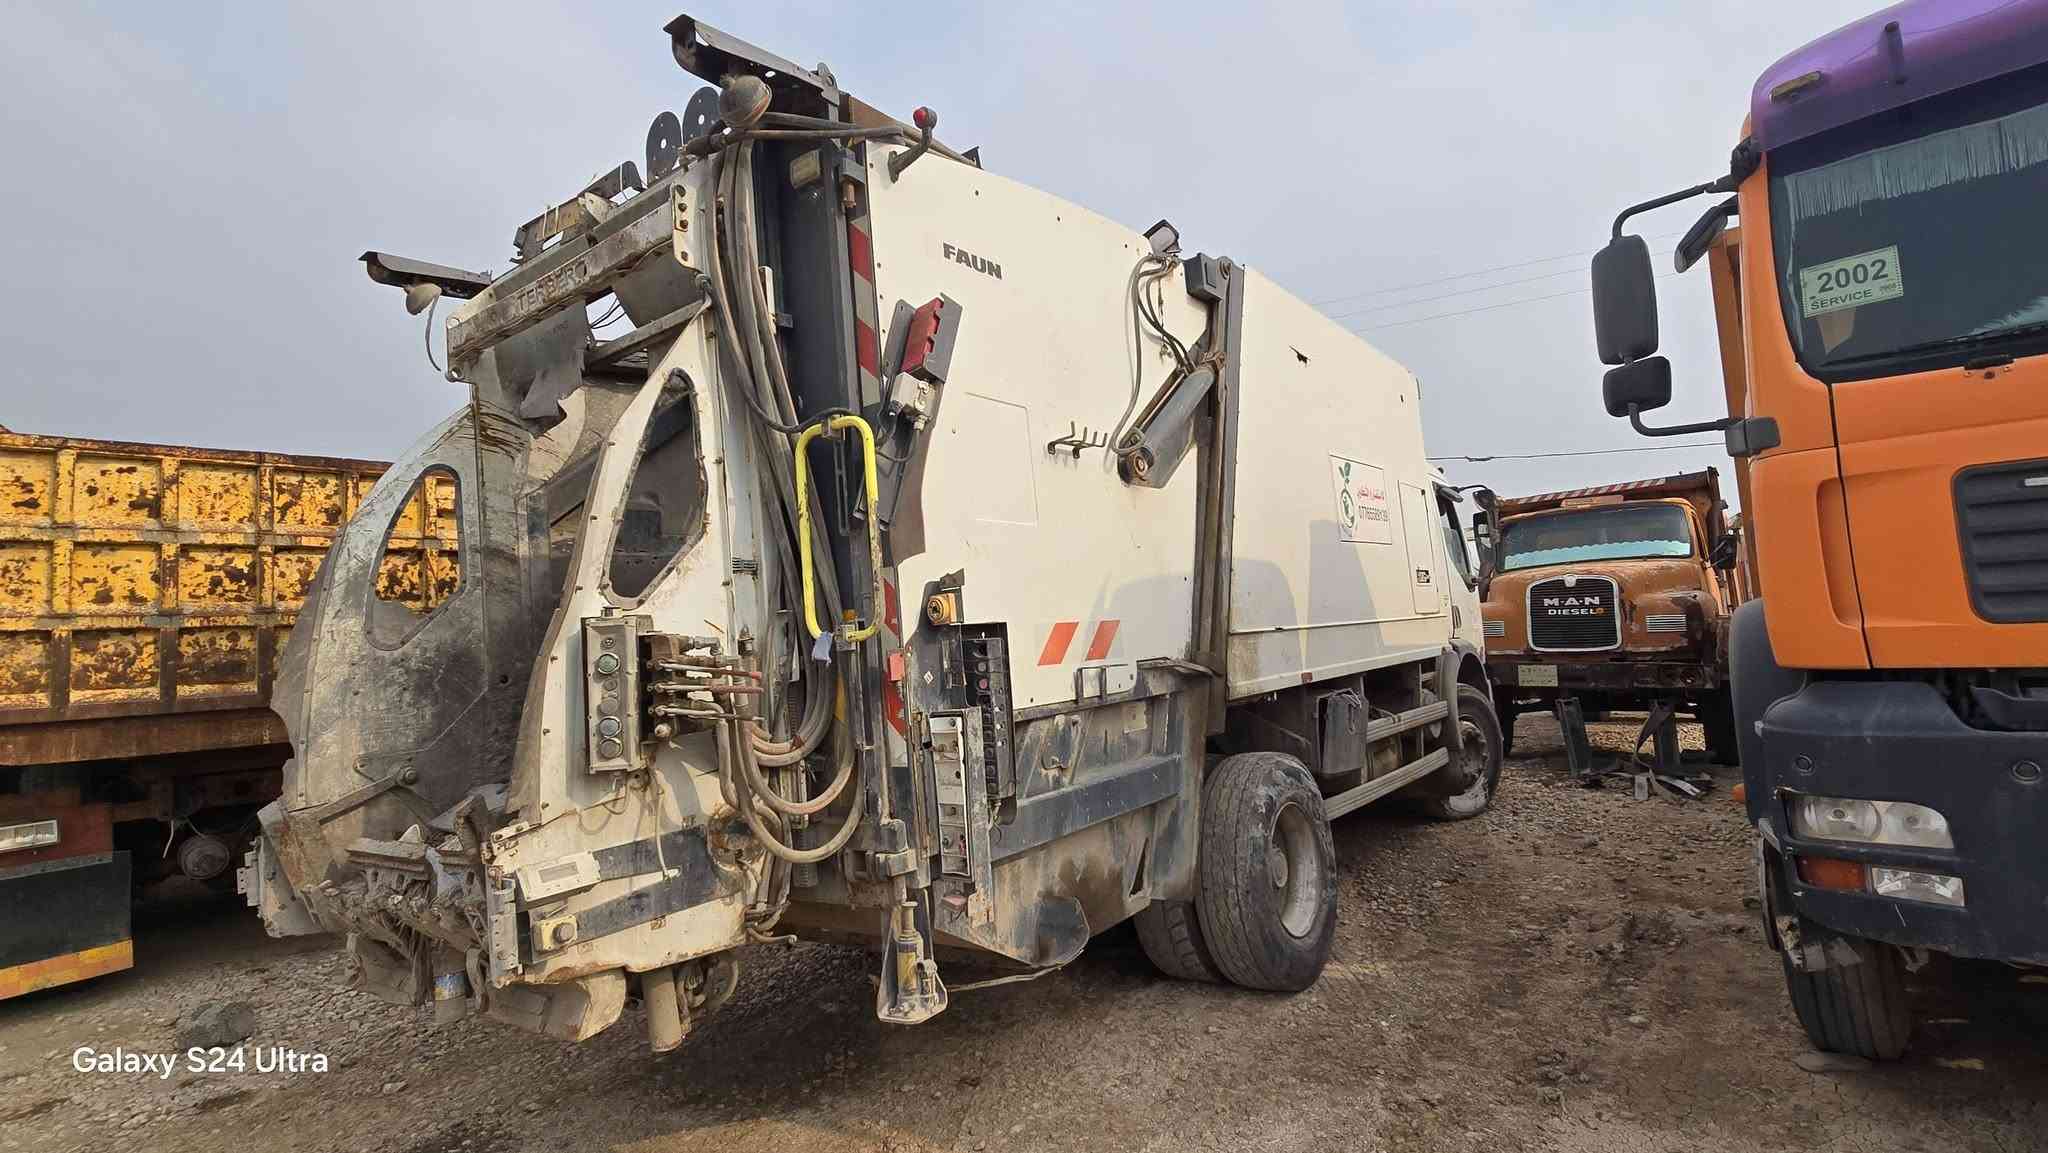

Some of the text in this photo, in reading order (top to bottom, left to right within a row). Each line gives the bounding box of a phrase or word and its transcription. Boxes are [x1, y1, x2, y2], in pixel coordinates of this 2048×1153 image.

[943, 242, 1002, 280] FAUN
[1817, 259, 1888, 293] 2002
[1809, 289, 1873, 310] SERVICE
[1548, 608, 1597, 616] DIESEL
